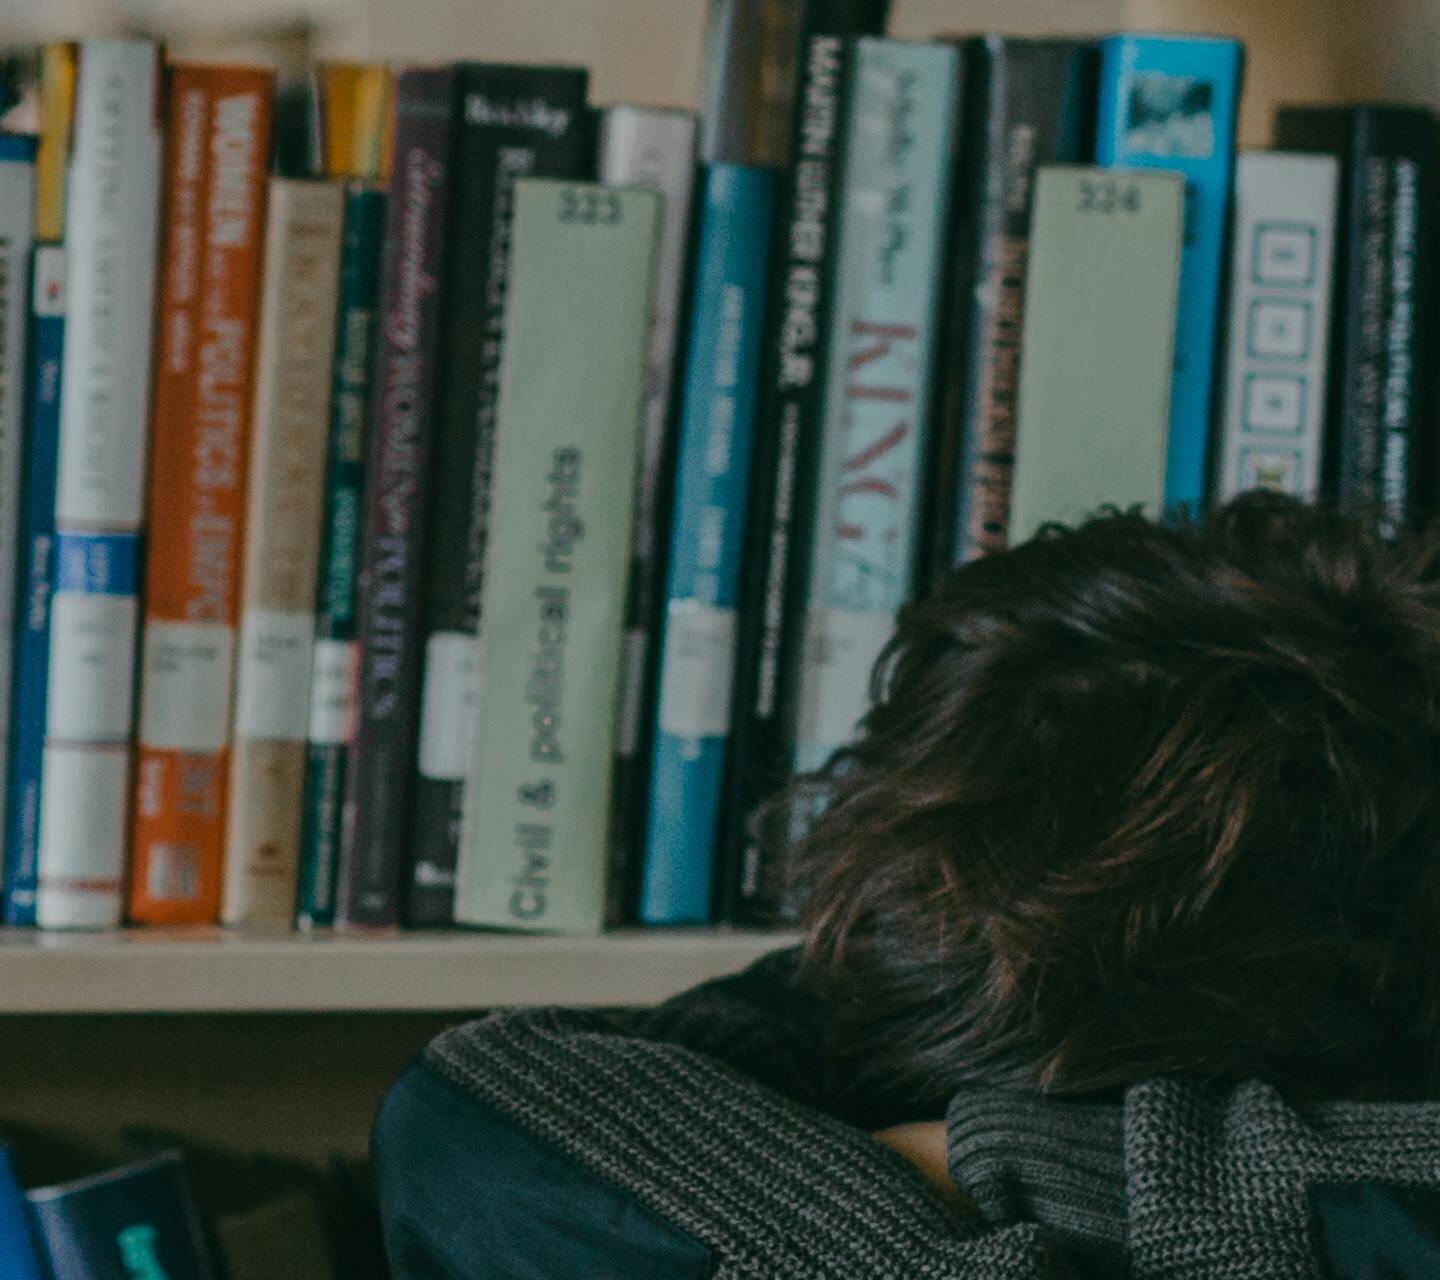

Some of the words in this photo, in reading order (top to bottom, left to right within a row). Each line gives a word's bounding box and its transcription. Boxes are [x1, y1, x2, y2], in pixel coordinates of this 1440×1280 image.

[534, 444, 584, 575] rights
[523, 584, 571, 766] political
[516, 779, 556, 812] &
[509, 822, 550, 923] Civil
